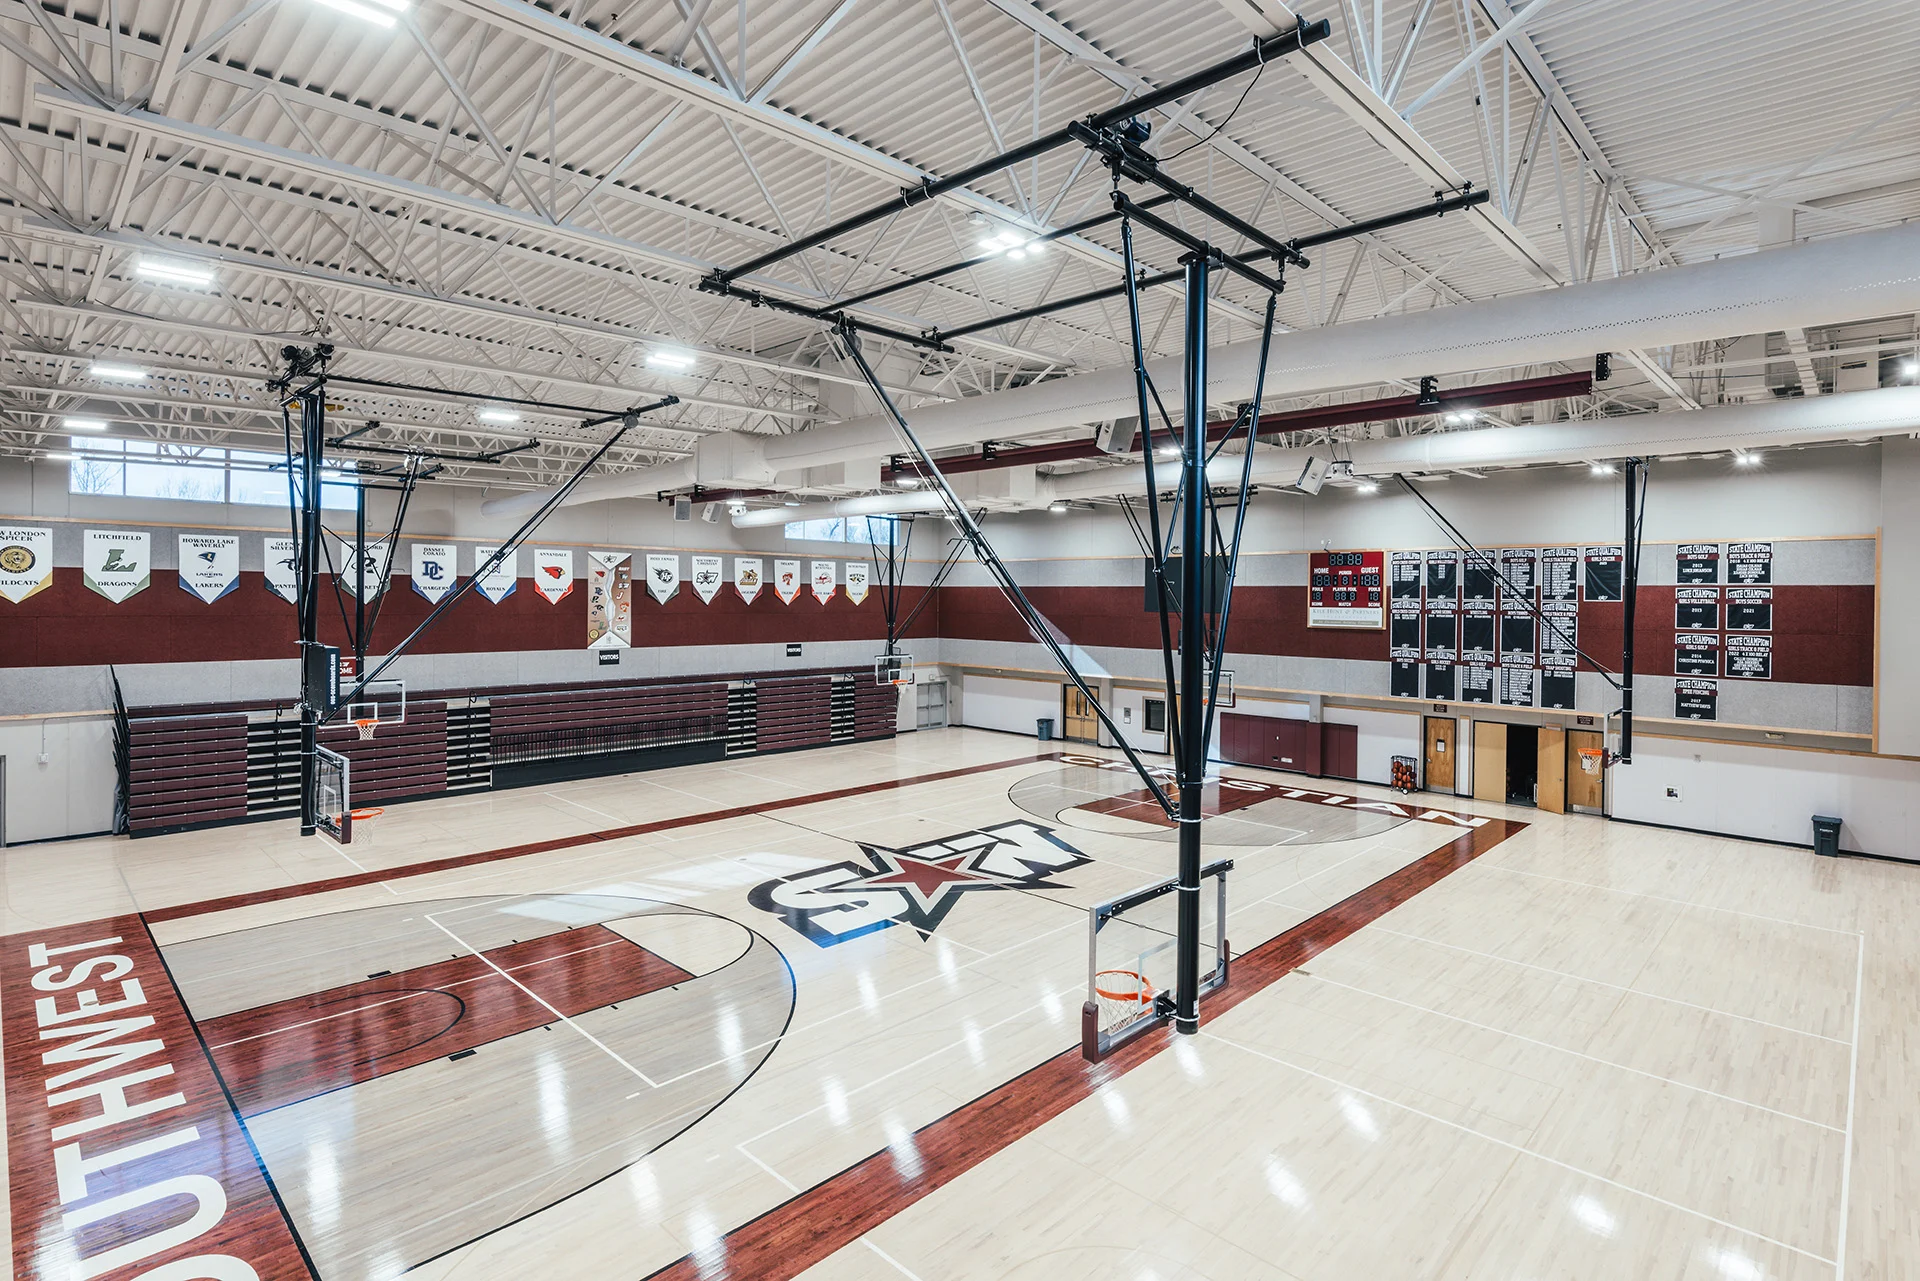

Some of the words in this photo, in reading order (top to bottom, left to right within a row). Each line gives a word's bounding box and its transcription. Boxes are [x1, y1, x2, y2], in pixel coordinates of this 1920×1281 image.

[1679, 546, 1692, 554] STATE
[1693, 545, 1717, 553] CHAMPION
[1745, 544, 1770, 552] CHAMPION
[1692, 589, 1717, 598] CHAMPION
[1744, 590, 1770, 598] CHAMPION
[1692, 636, 1716, 645] CHAMPION
[1744, 637, 1769, 646] CHAMPION
[1692, 680, 1716, 689] CHAMPION
